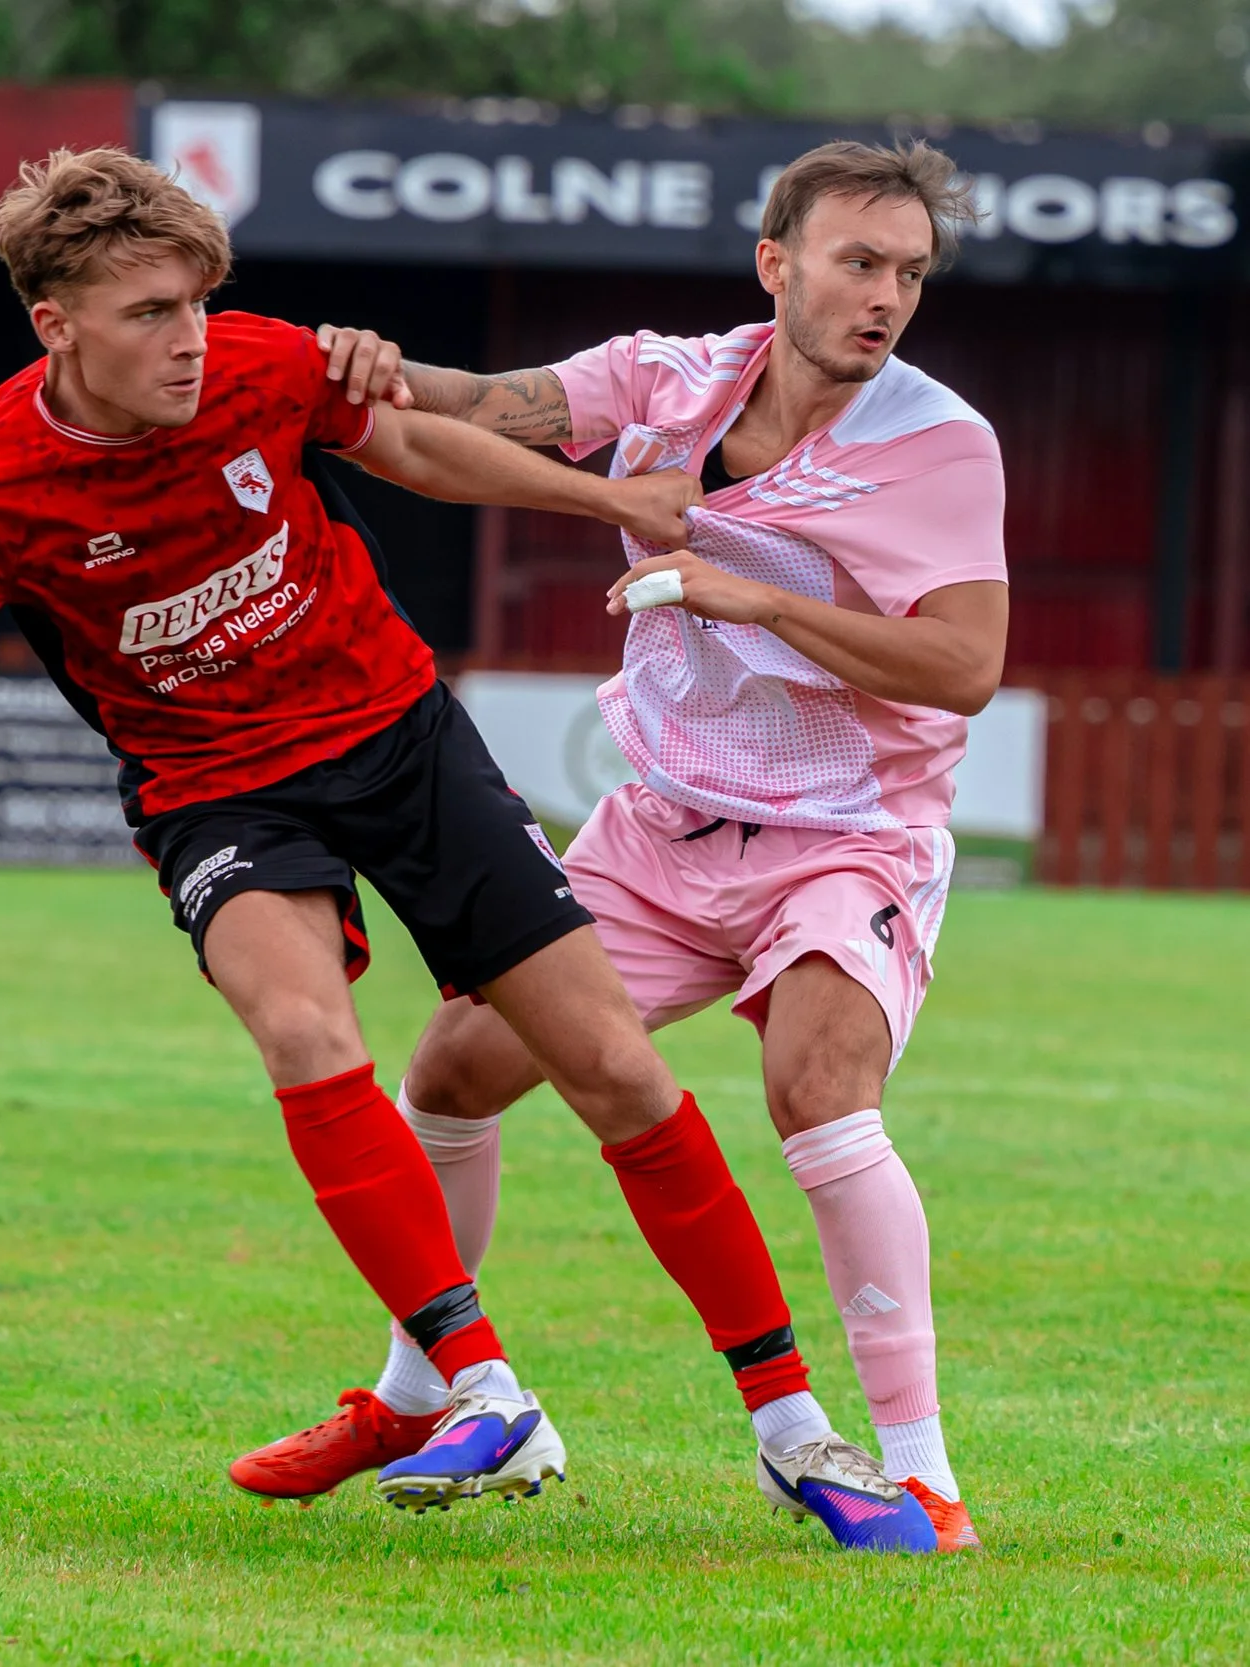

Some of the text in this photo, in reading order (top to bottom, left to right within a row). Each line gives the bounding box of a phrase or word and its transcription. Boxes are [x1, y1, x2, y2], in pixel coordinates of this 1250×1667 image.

[312, 149, 1238, 249] COLNE JIORS
[85, 547, 135, 569] STANNO
[129, 539, 285, 647] PERRYS
[140, 582, 299, 673] Perrys Nelson
[146, 659, 237, 694] MODA
[870, 903, 900, 950] 6
